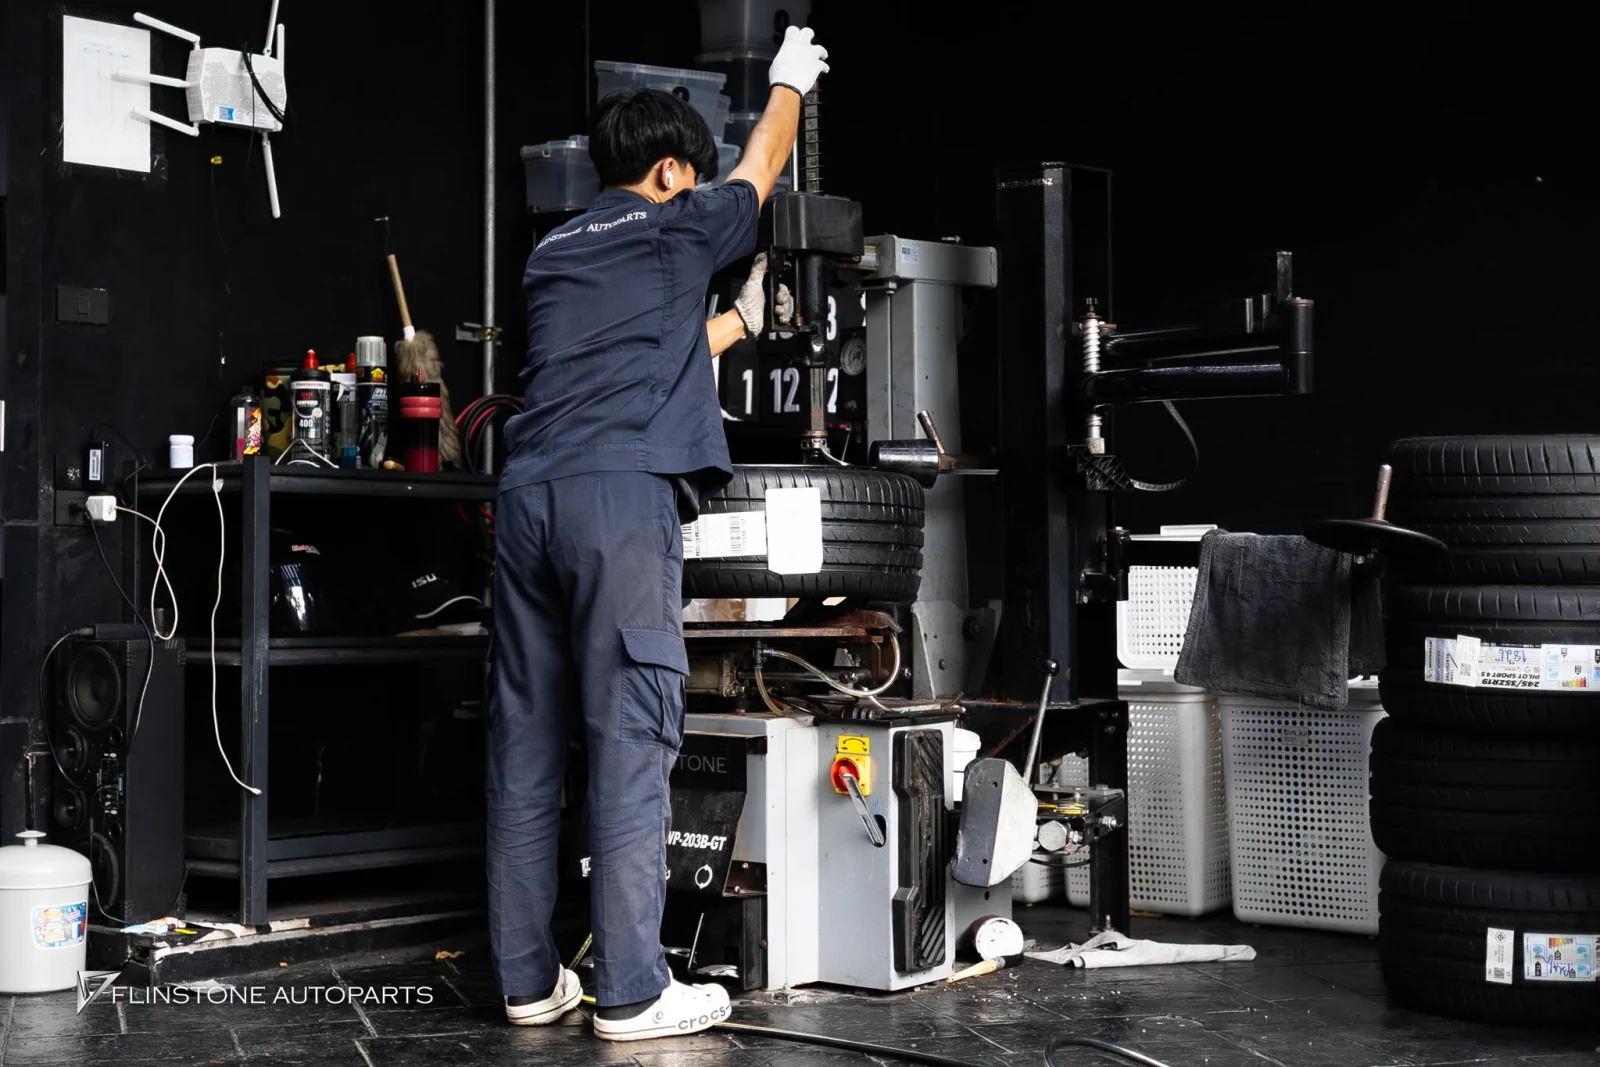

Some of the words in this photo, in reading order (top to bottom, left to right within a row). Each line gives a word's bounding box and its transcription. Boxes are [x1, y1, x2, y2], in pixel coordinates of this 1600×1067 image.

[586, 211, 647, 232] AUTOPARTS
[770, 367, 800, 413] 12
[299, 419, 314, 428] 400
[1482, 679, 1540, 688] 245/35ZR19
[673, 754, 727, 773] TONE
[678, 1006, 726, 1030] crocs
